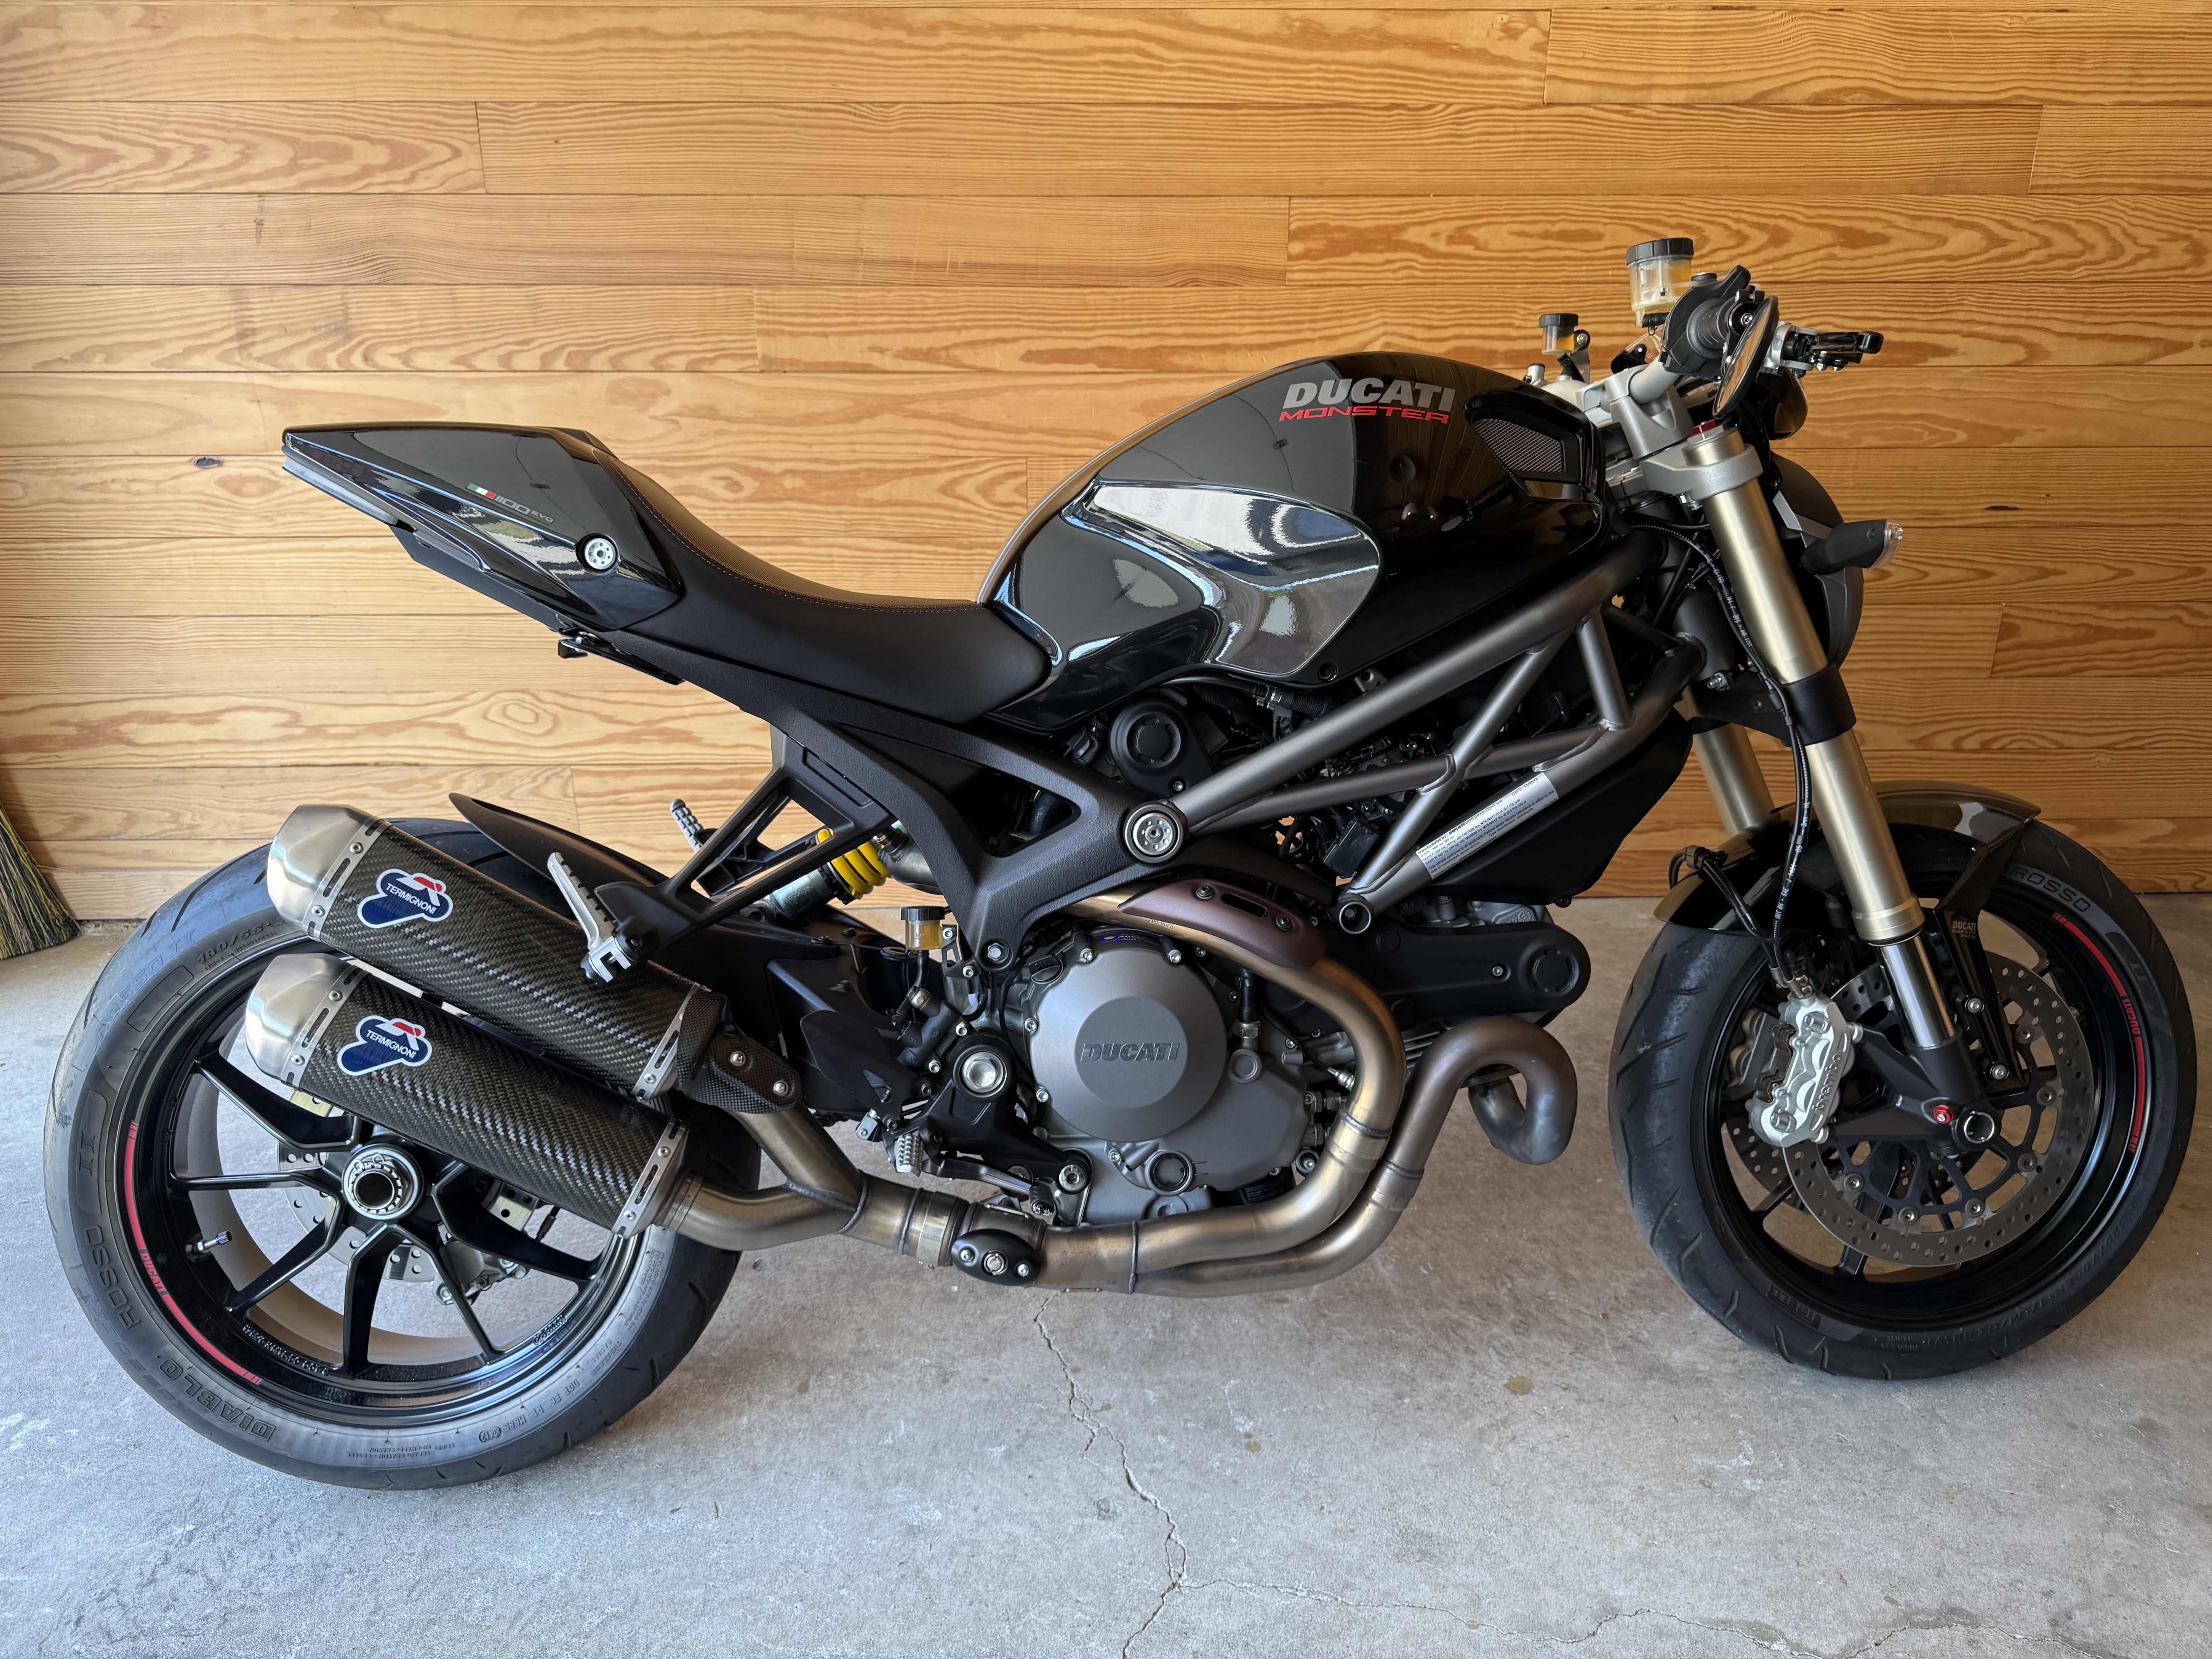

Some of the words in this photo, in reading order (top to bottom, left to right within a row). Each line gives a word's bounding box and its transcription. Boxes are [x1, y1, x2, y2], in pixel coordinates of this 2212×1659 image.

[1283, 378, 1455, 412] DUCATI
[1279, 406, 1449, 424] MONSTER
[495, 495, 532, 515] 1100
[1732, 613, 1741, 624] SAE
[1417, 838, 1441, 854] Manufactured
[386, 883, 436, 915] TERMIGNONI
[1774, 909, 1783, 919] DOT
[1780, 886, 1790, 897] SAE
[2011, 866, 2091, 913] ROSSO
[1952, 921, 1976, 931] DUCATI
[2122, 998, 2140, 1035] DUCATI
[366, 1029, 417, 1059] TERMIGNONI
[1080, 1042, 1180, 1062] DUCATI
[1812, 1054, 1841, 1112] brembo
[84, 1225, 142, 1329] ROSSO
[141, 1253, 166, 1294] DUCATI
[159, 1358, 276, 1442] DIABLO
[562, 1377, 580, 1395] DOT
